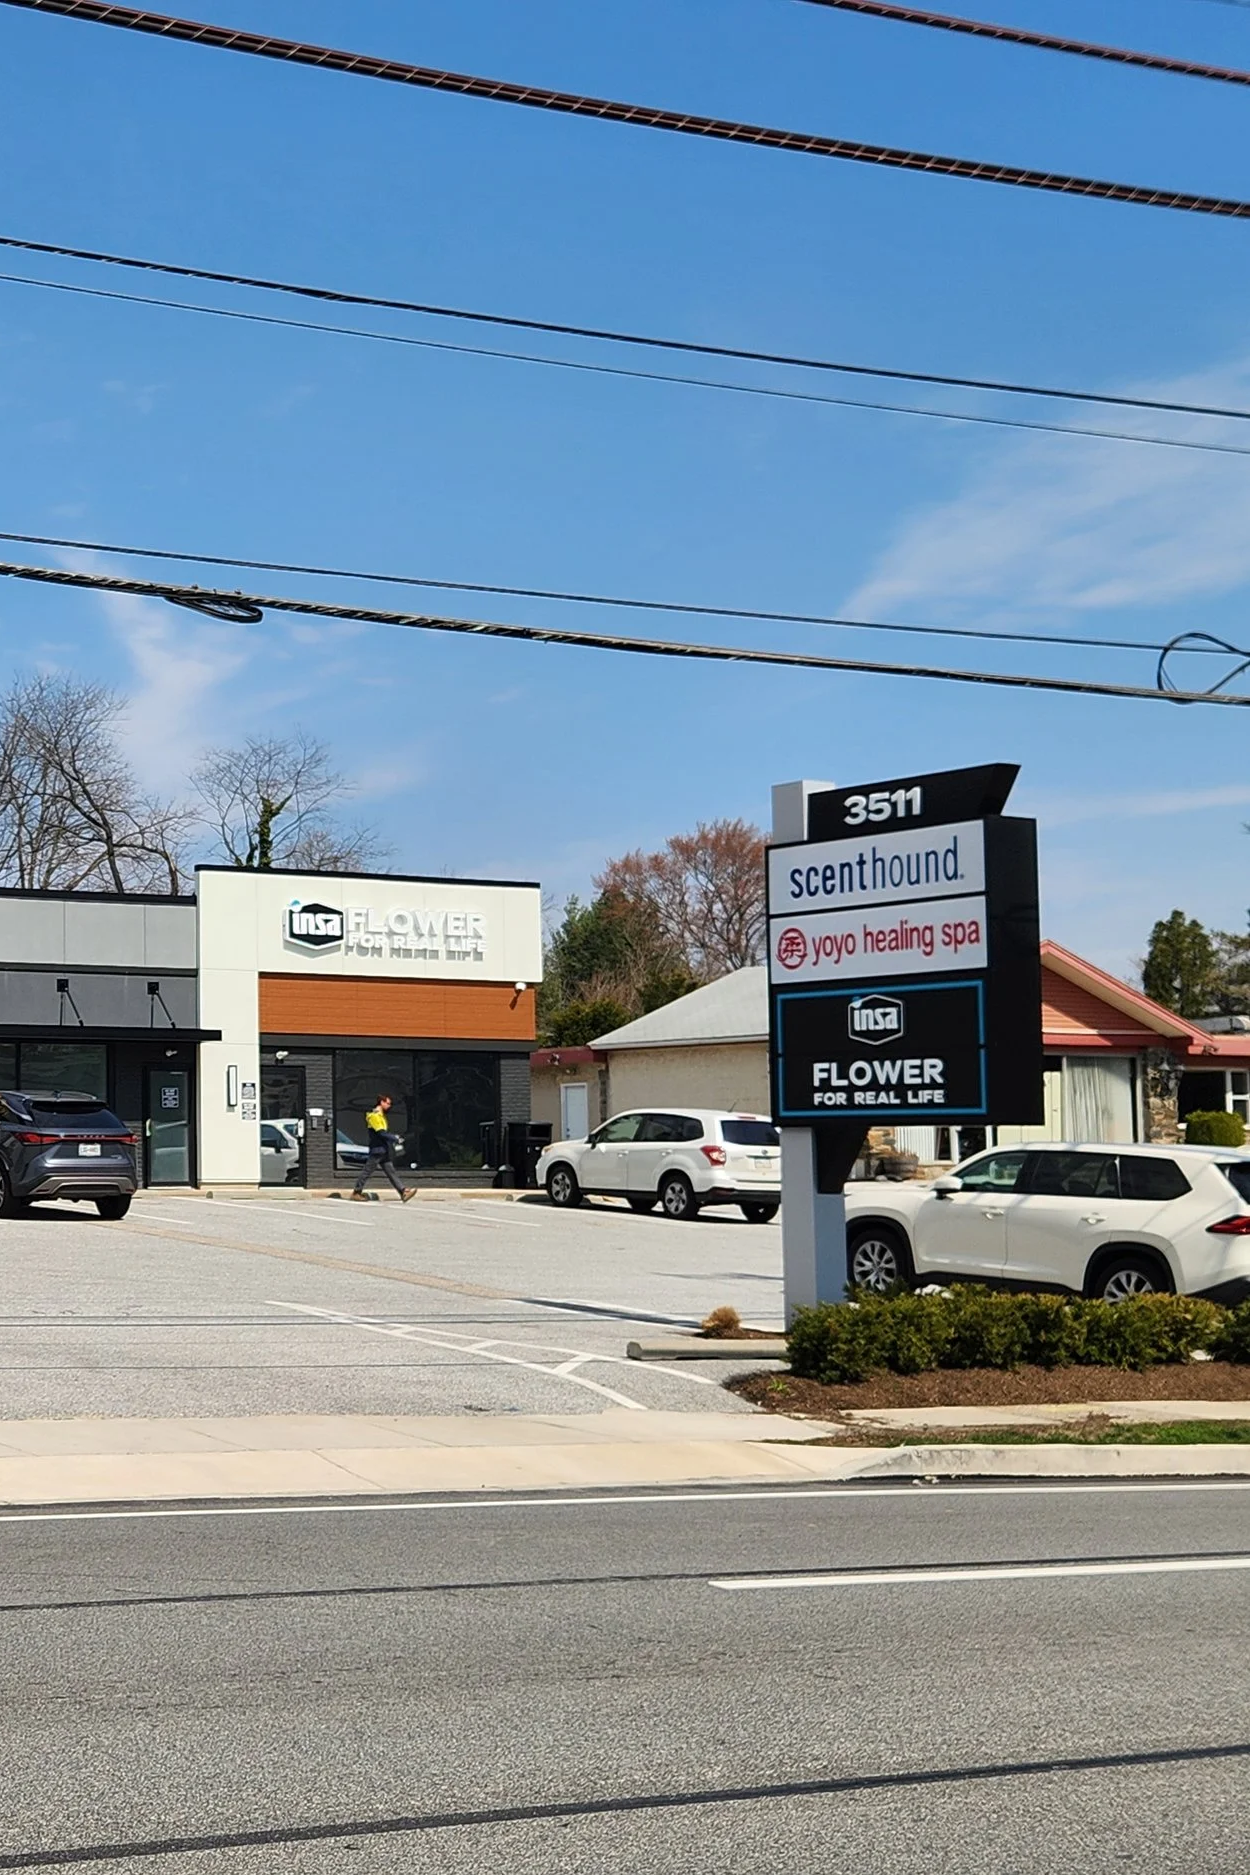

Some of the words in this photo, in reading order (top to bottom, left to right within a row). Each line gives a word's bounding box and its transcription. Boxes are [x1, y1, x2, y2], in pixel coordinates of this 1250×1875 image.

[844, 786, 922, 825] 3511
[291, 903, 342, 936] insa
[349, 907, 487, 938] FLOWER
[349, 934, 384, 949] FOR
[396, 936, 439, 951] REAL
[450, 937, 488, 952] LIFE
[812, 931, 856, 966] yoyo
[863, 920, 934, 956] healing
[942, 920, 981, 953] spa
[853, 1000, 898, 1031] insa
[813, 1058, 944, 1087] FLOWER
[813, 1092, 847, 1106] FOR
[854, 1091, 901, 1105] REAL
[907, 1090, 945, 1104] LIFE
